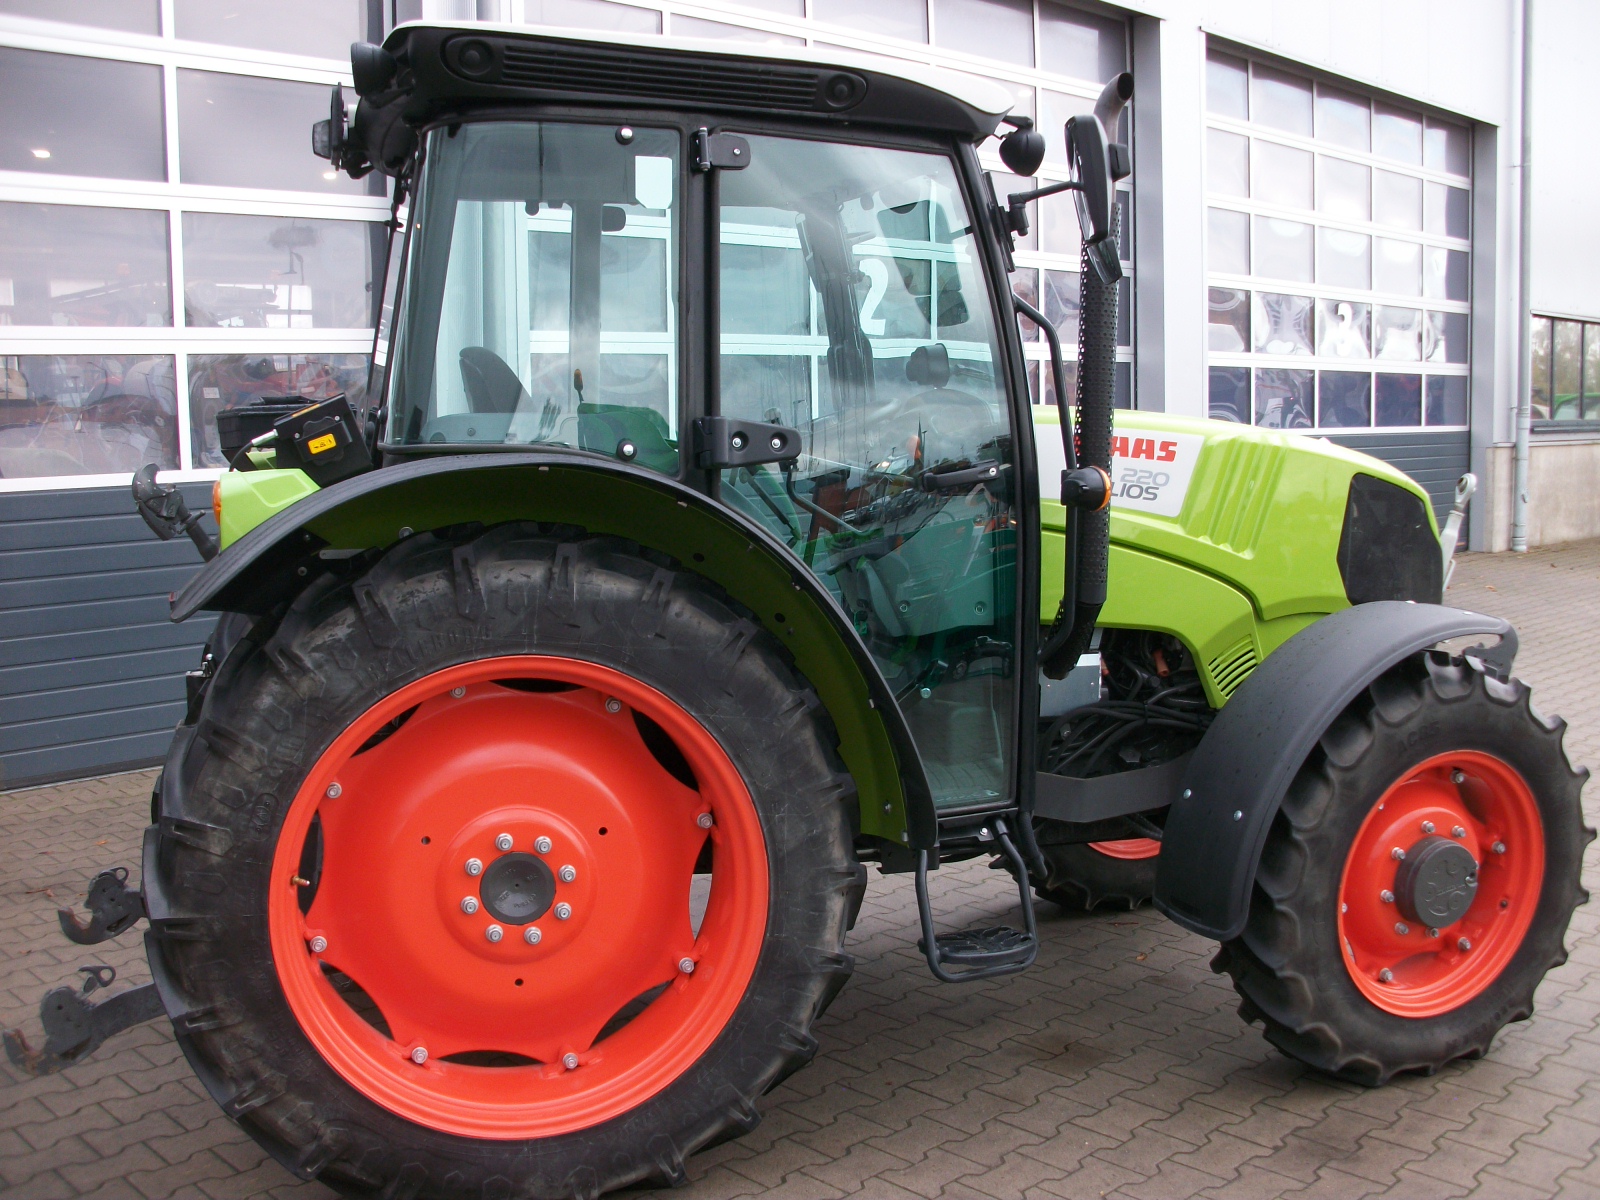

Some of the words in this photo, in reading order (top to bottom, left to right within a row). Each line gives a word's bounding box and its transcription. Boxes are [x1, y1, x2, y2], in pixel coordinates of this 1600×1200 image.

[858, 258, 889, 336] 2
[1109, 435, 1178, 463] AAS
[1119, 467, 1170, 488] 220
[1110, 481, 1160, 501] LIOS
